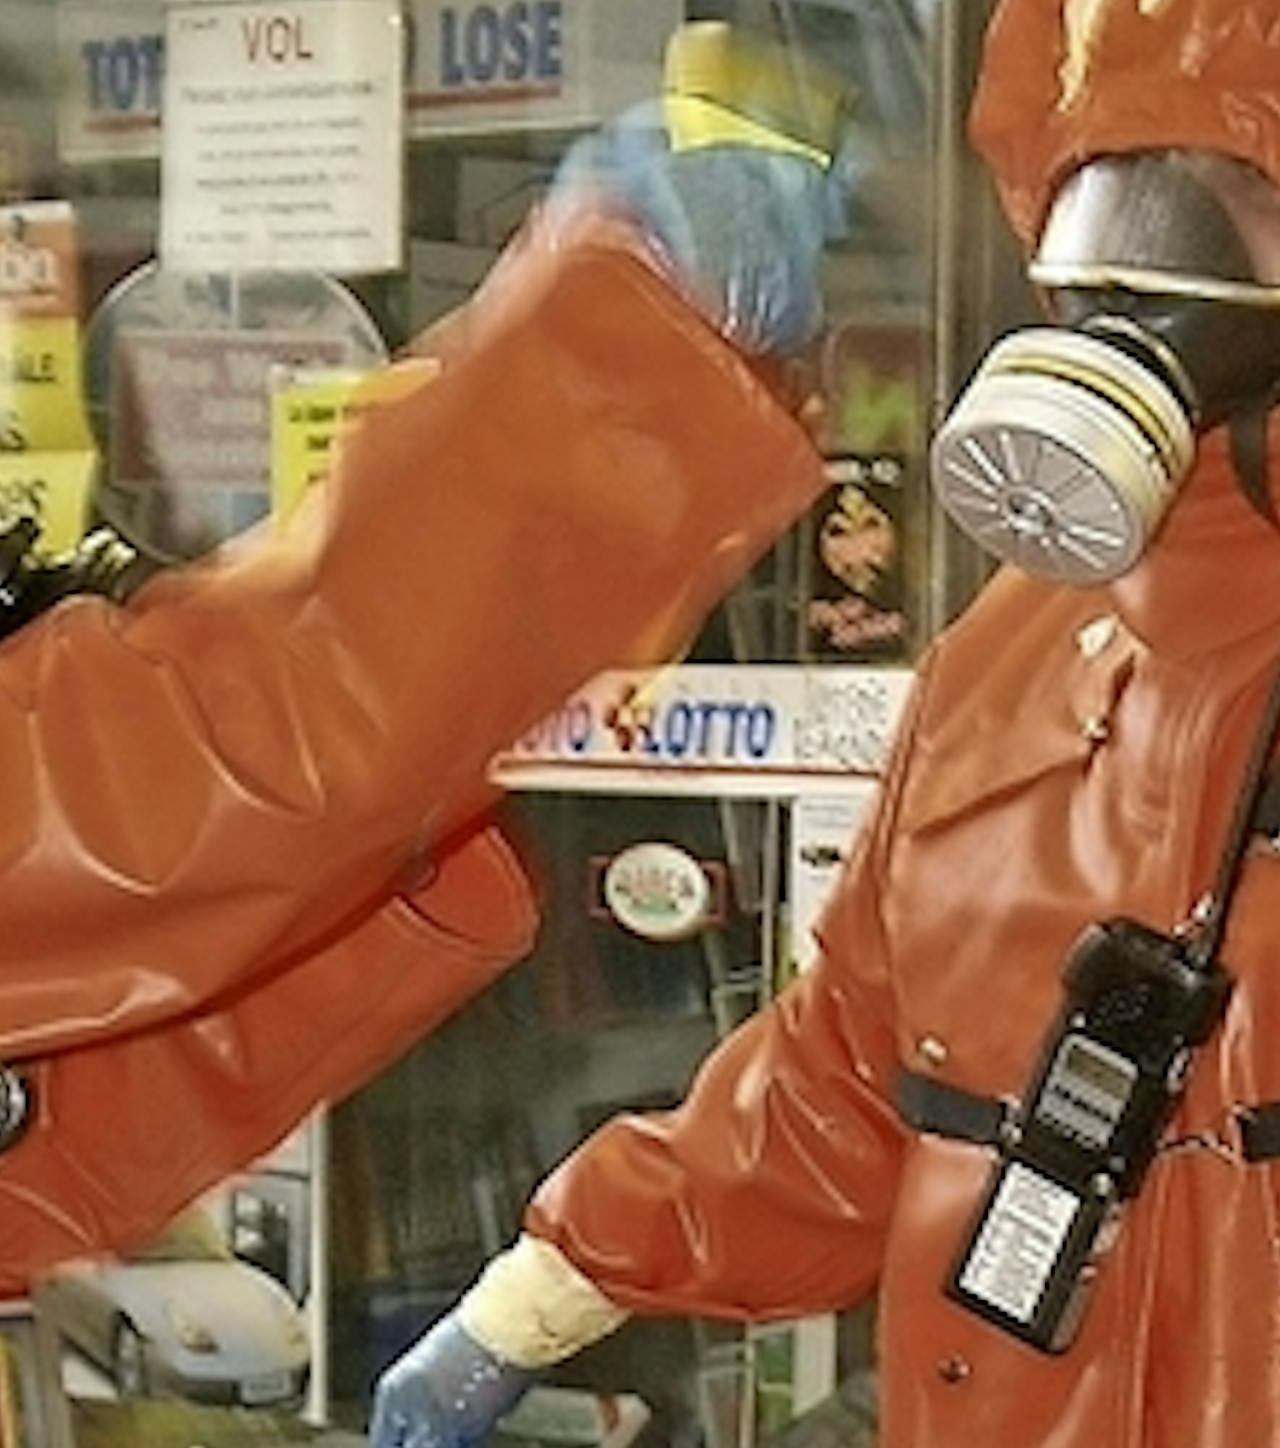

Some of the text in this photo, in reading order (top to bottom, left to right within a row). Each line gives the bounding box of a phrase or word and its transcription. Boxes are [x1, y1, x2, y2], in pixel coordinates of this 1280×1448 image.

[240, 15, 313, 62] VOL
[441, 0, 562, 87] LOSE
[644, 702, 774, 758] LOTTO
